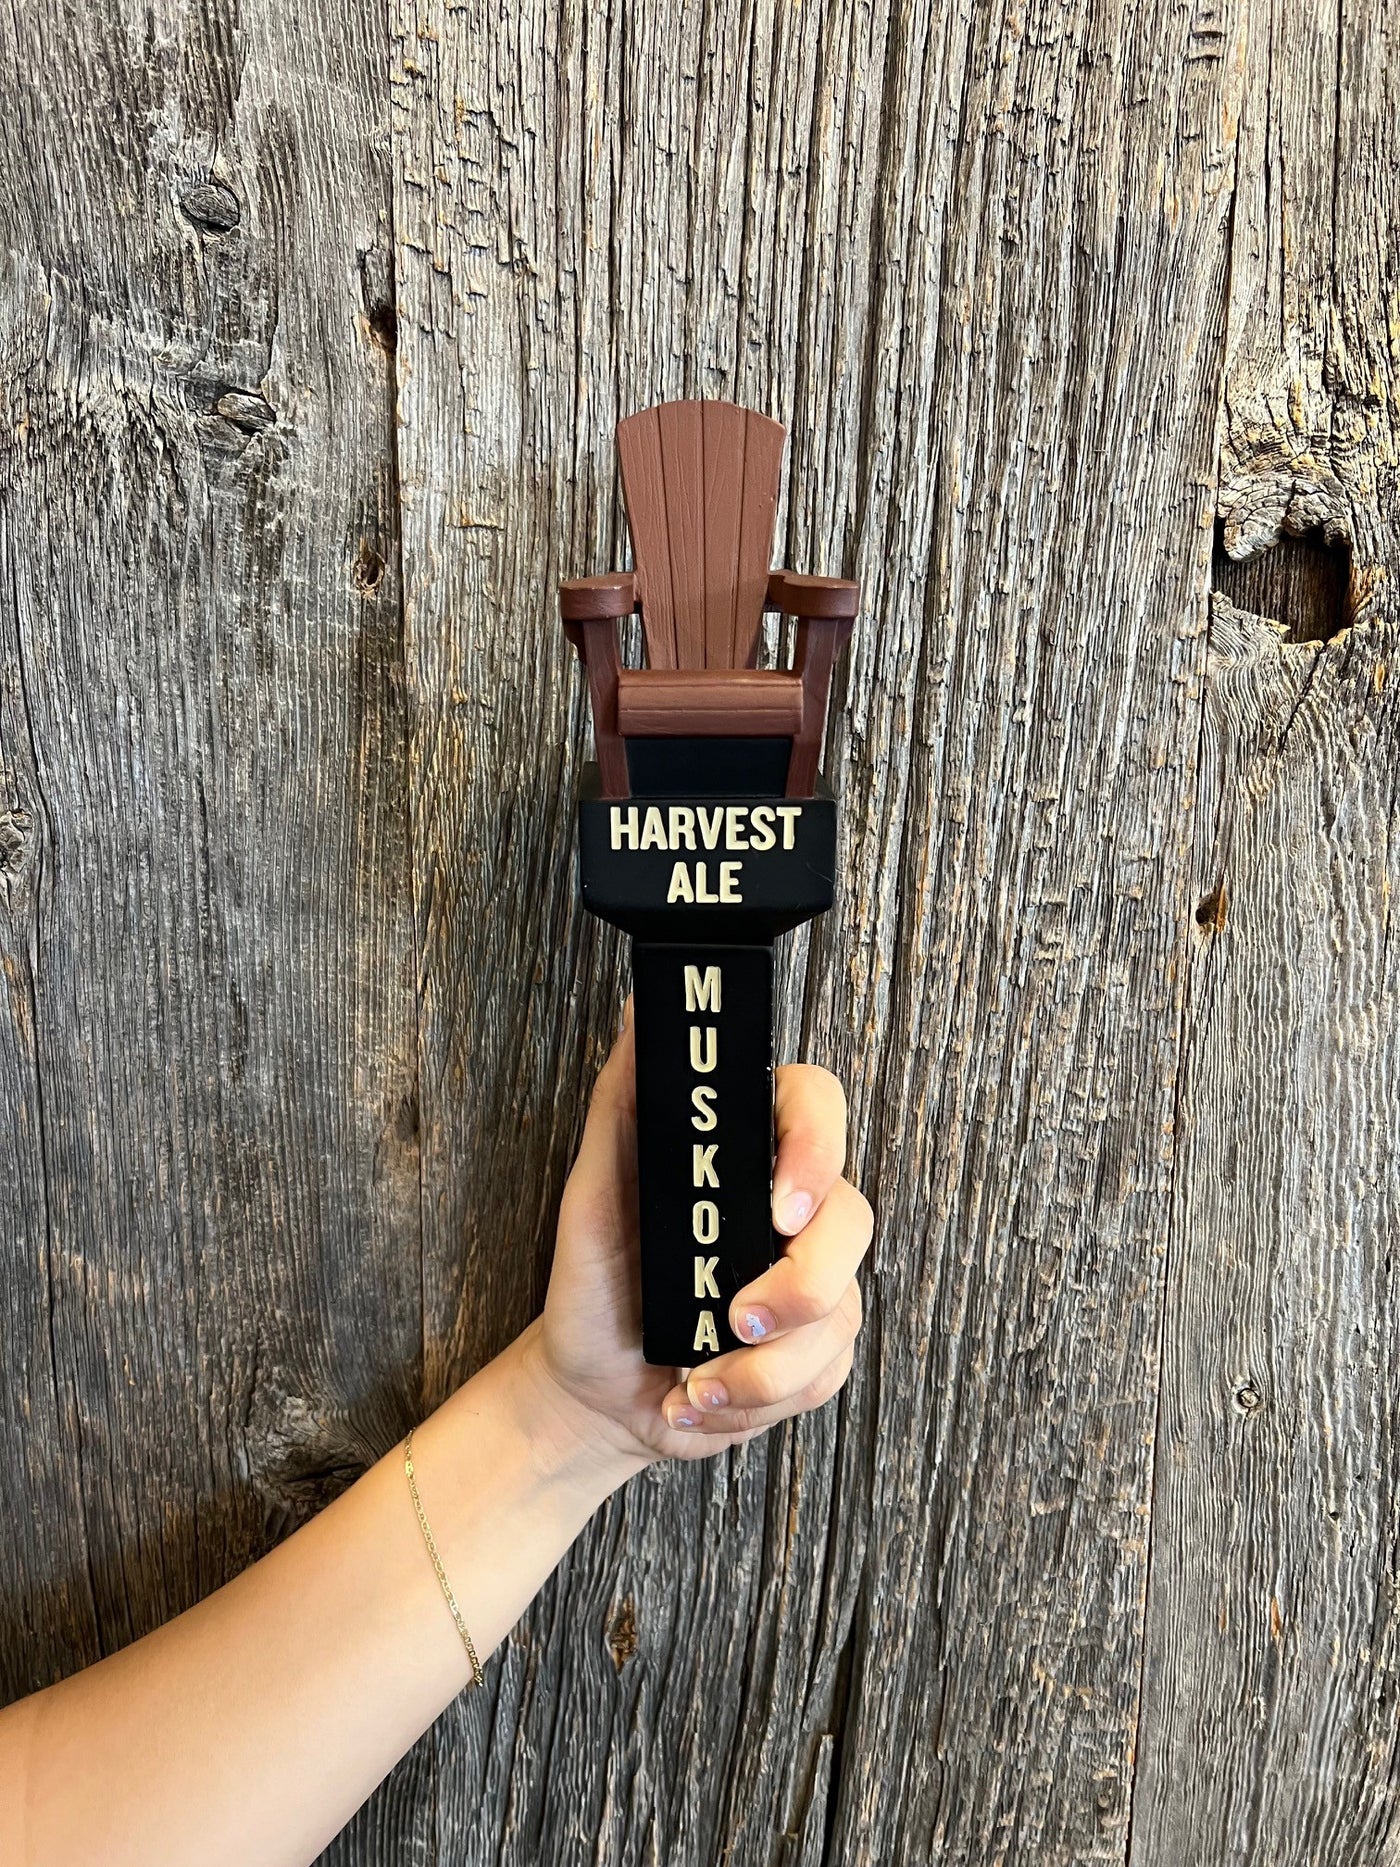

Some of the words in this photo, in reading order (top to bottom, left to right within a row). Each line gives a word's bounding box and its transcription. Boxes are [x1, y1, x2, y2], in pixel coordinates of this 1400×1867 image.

[610, 806, 802, 850] HARVEST
[666, 861, 743, 904] ALE
[684, 965, 722, 1352] MUSKOKA
